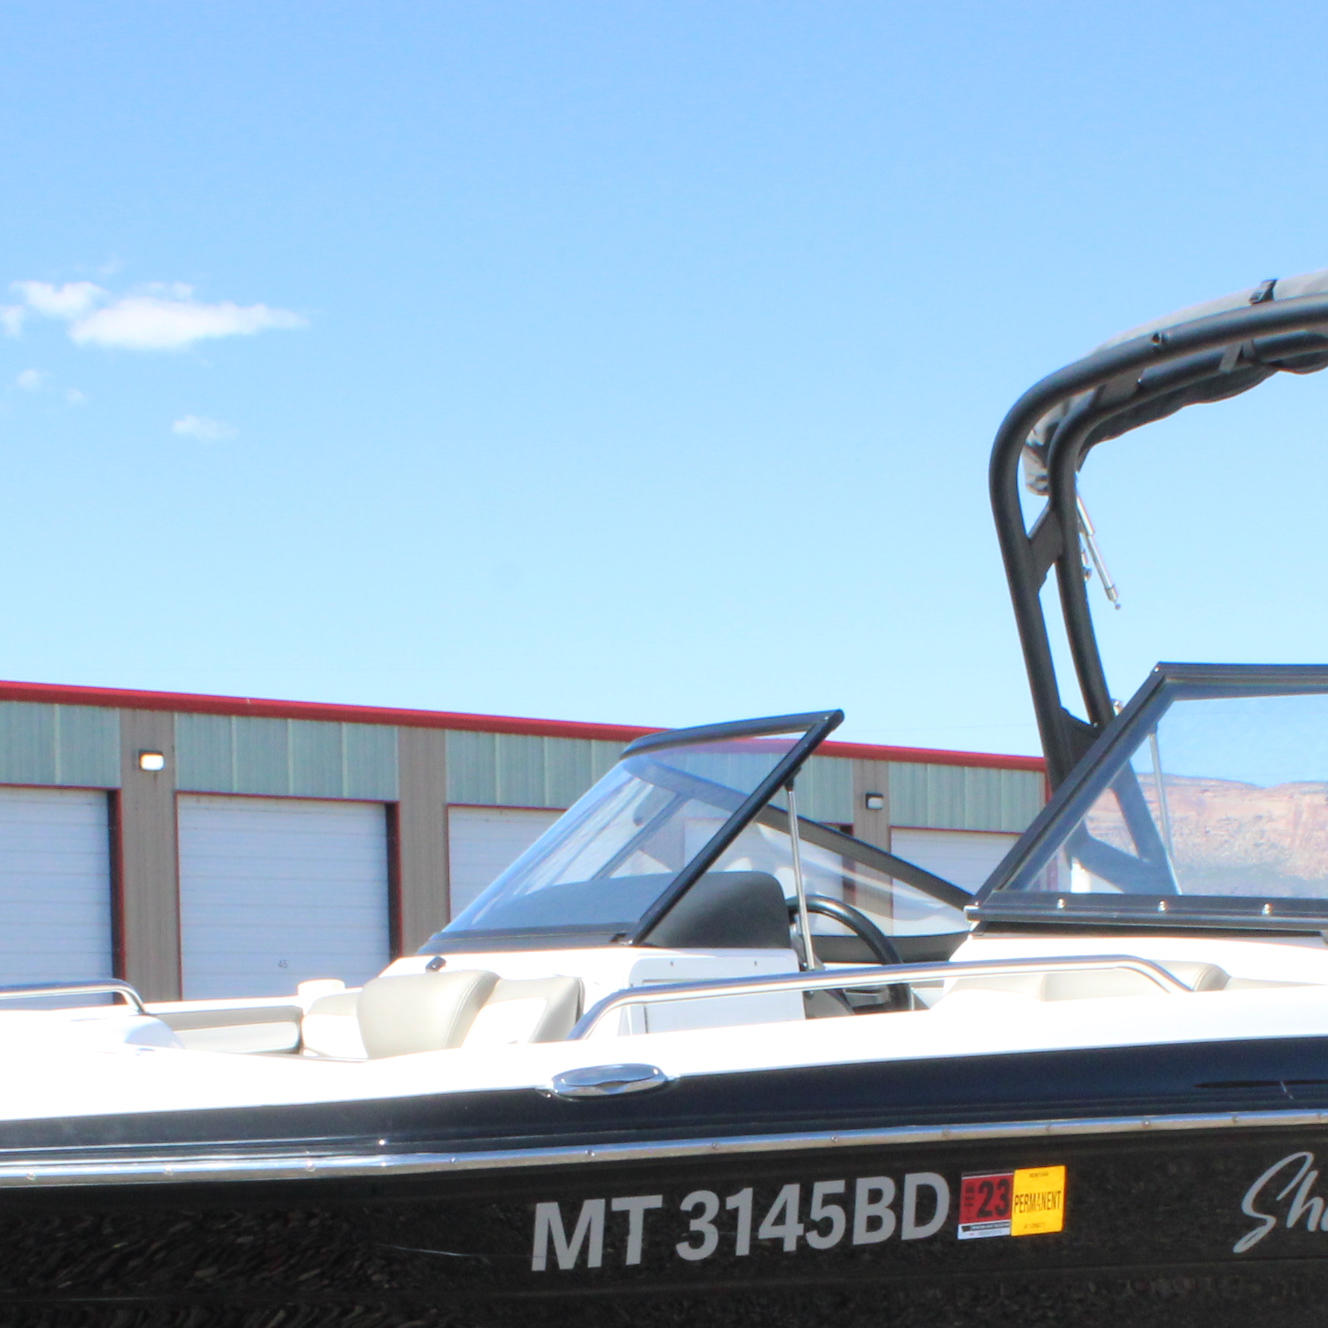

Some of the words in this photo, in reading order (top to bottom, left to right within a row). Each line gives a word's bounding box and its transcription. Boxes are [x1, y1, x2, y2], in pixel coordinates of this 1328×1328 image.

[976, 1178, 1011, 1219] 23
[1013, 1190, 1062, 1214] PERMANENT
[531, 1194, 664, 1272] MT
[675, 1171, 950, 1262] 3145BD
